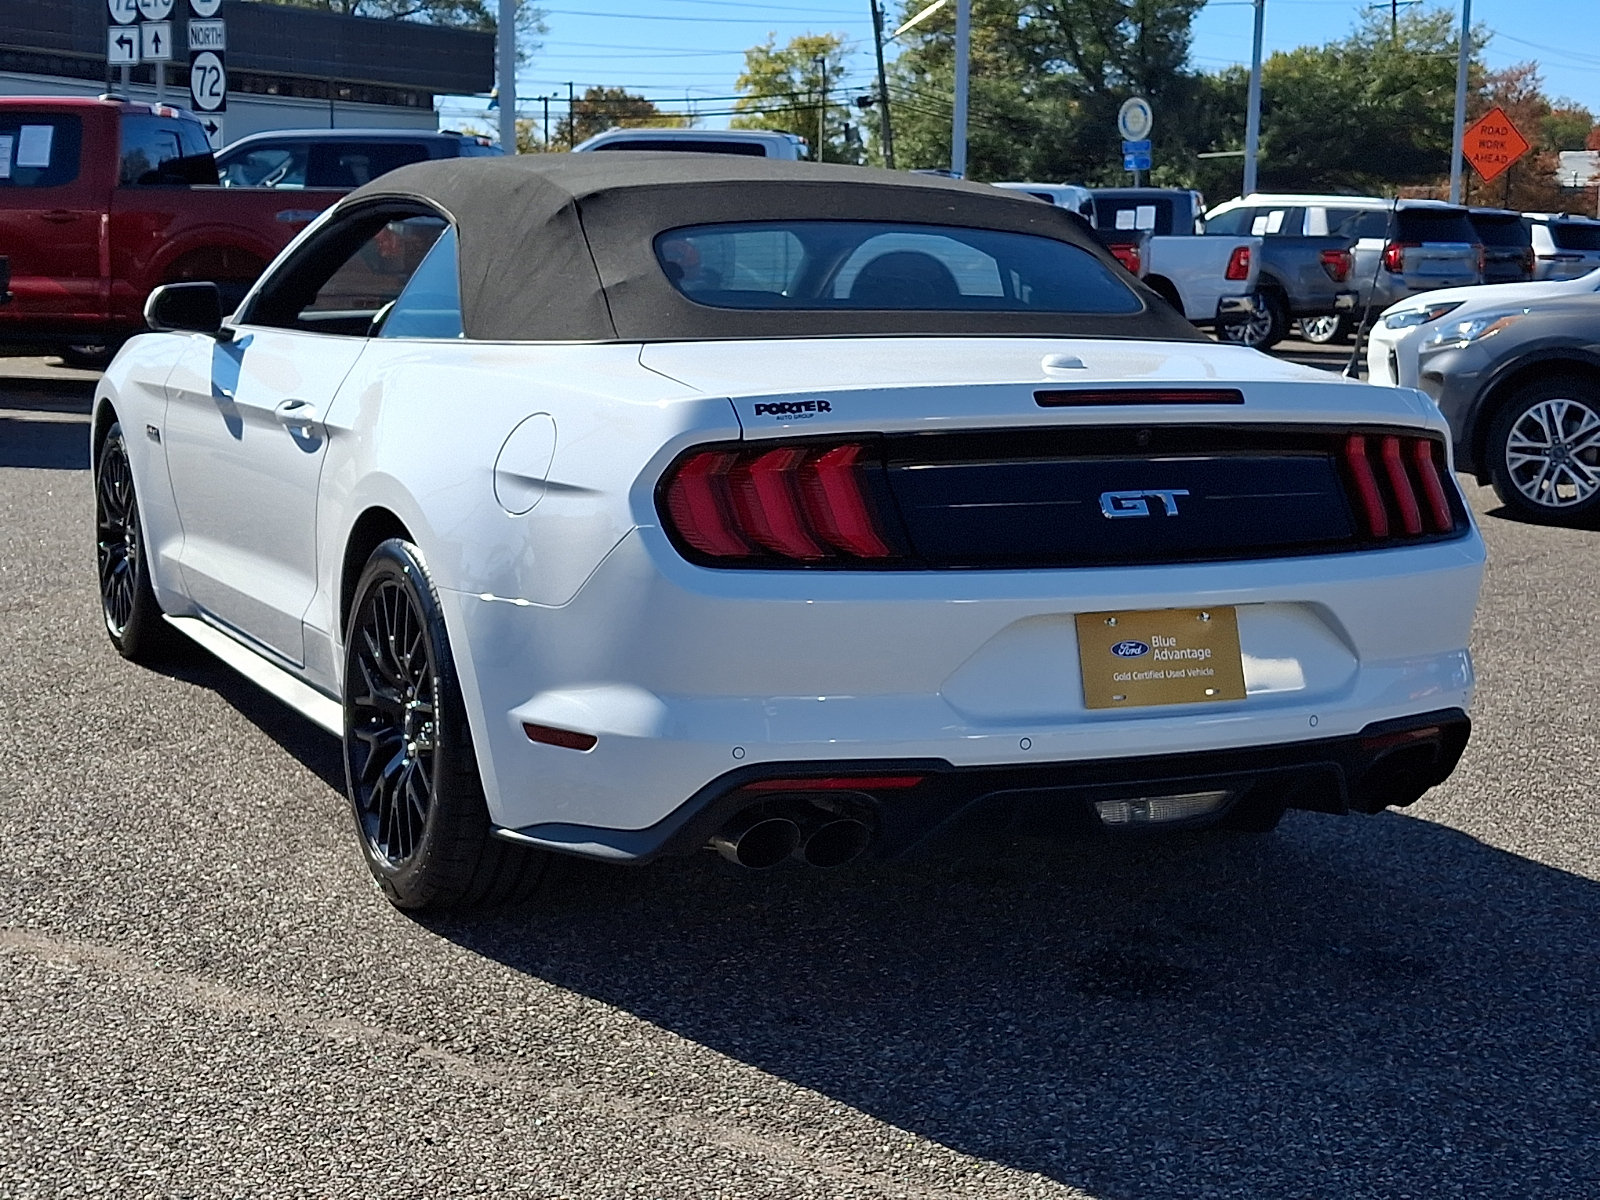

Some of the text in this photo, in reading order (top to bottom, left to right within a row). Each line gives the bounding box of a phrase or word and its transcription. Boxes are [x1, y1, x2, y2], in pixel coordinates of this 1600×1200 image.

[190, 26, 222, 46] NORTH
[195, 64, 221, 97] 72
[1480, 125, 1508, 136] ROAD
[1478, 139, 1507, 149] WORK
[1473, 153, 1508, 164] AHEAD
[754, 400, 832, 416] PORTER
[793, 412, 814, 420] GROUP
[1099, 489, 1190, 518] GT
[1151, 635, 1176, 647] Blue
[1118, 643, 1142, 655] Ford
[1153, 648, 1211, 660] Advantage
[1113, 667, 1214, 681] Gold Certified Used Vehicle
